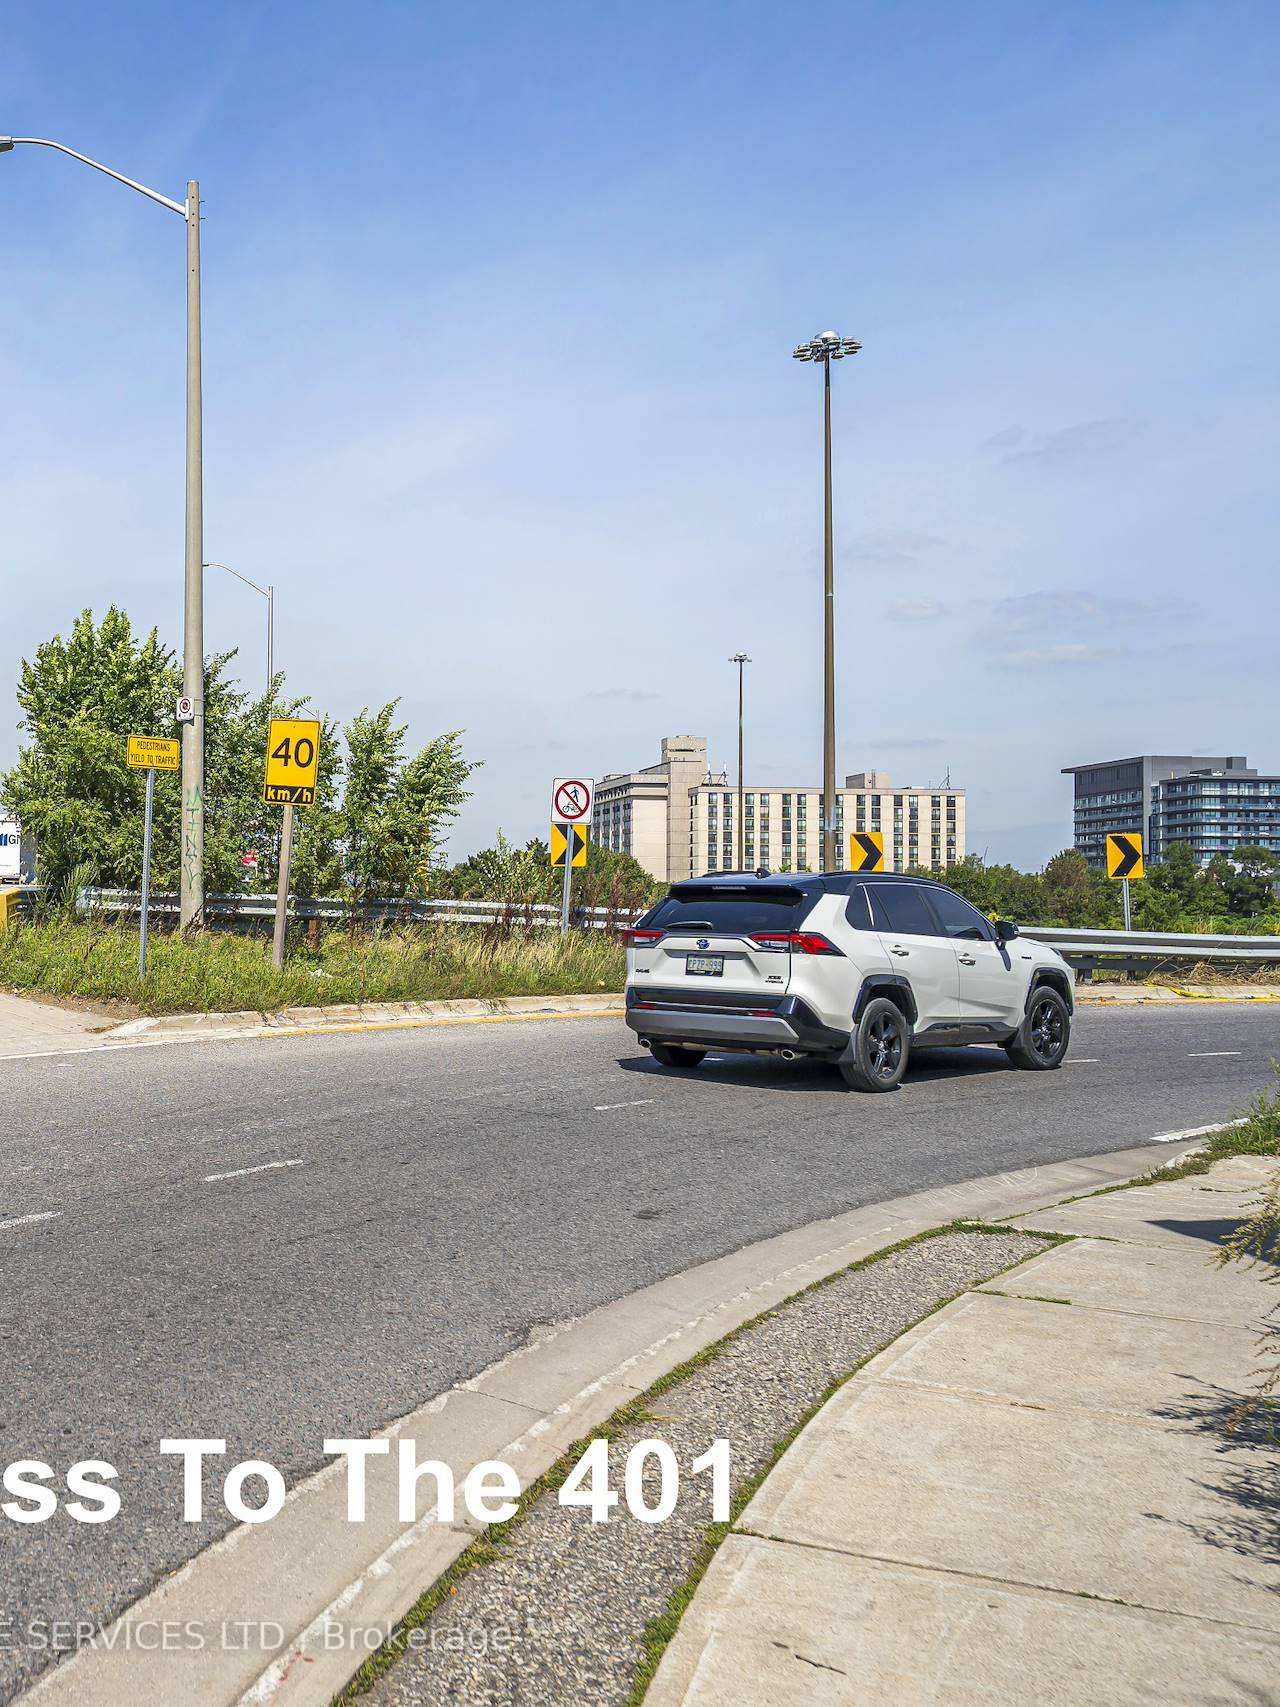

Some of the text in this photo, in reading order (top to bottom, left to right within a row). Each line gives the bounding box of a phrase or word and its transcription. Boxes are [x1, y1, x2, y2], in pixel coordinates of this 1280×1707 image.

[137, 740, 171, 752] PEDESTRIANS
[271, 737, 314, 768] 40
[130, 753, 176, 766] YIELD TO TRAFFIC
[267, 786, 312, 803] km/h
